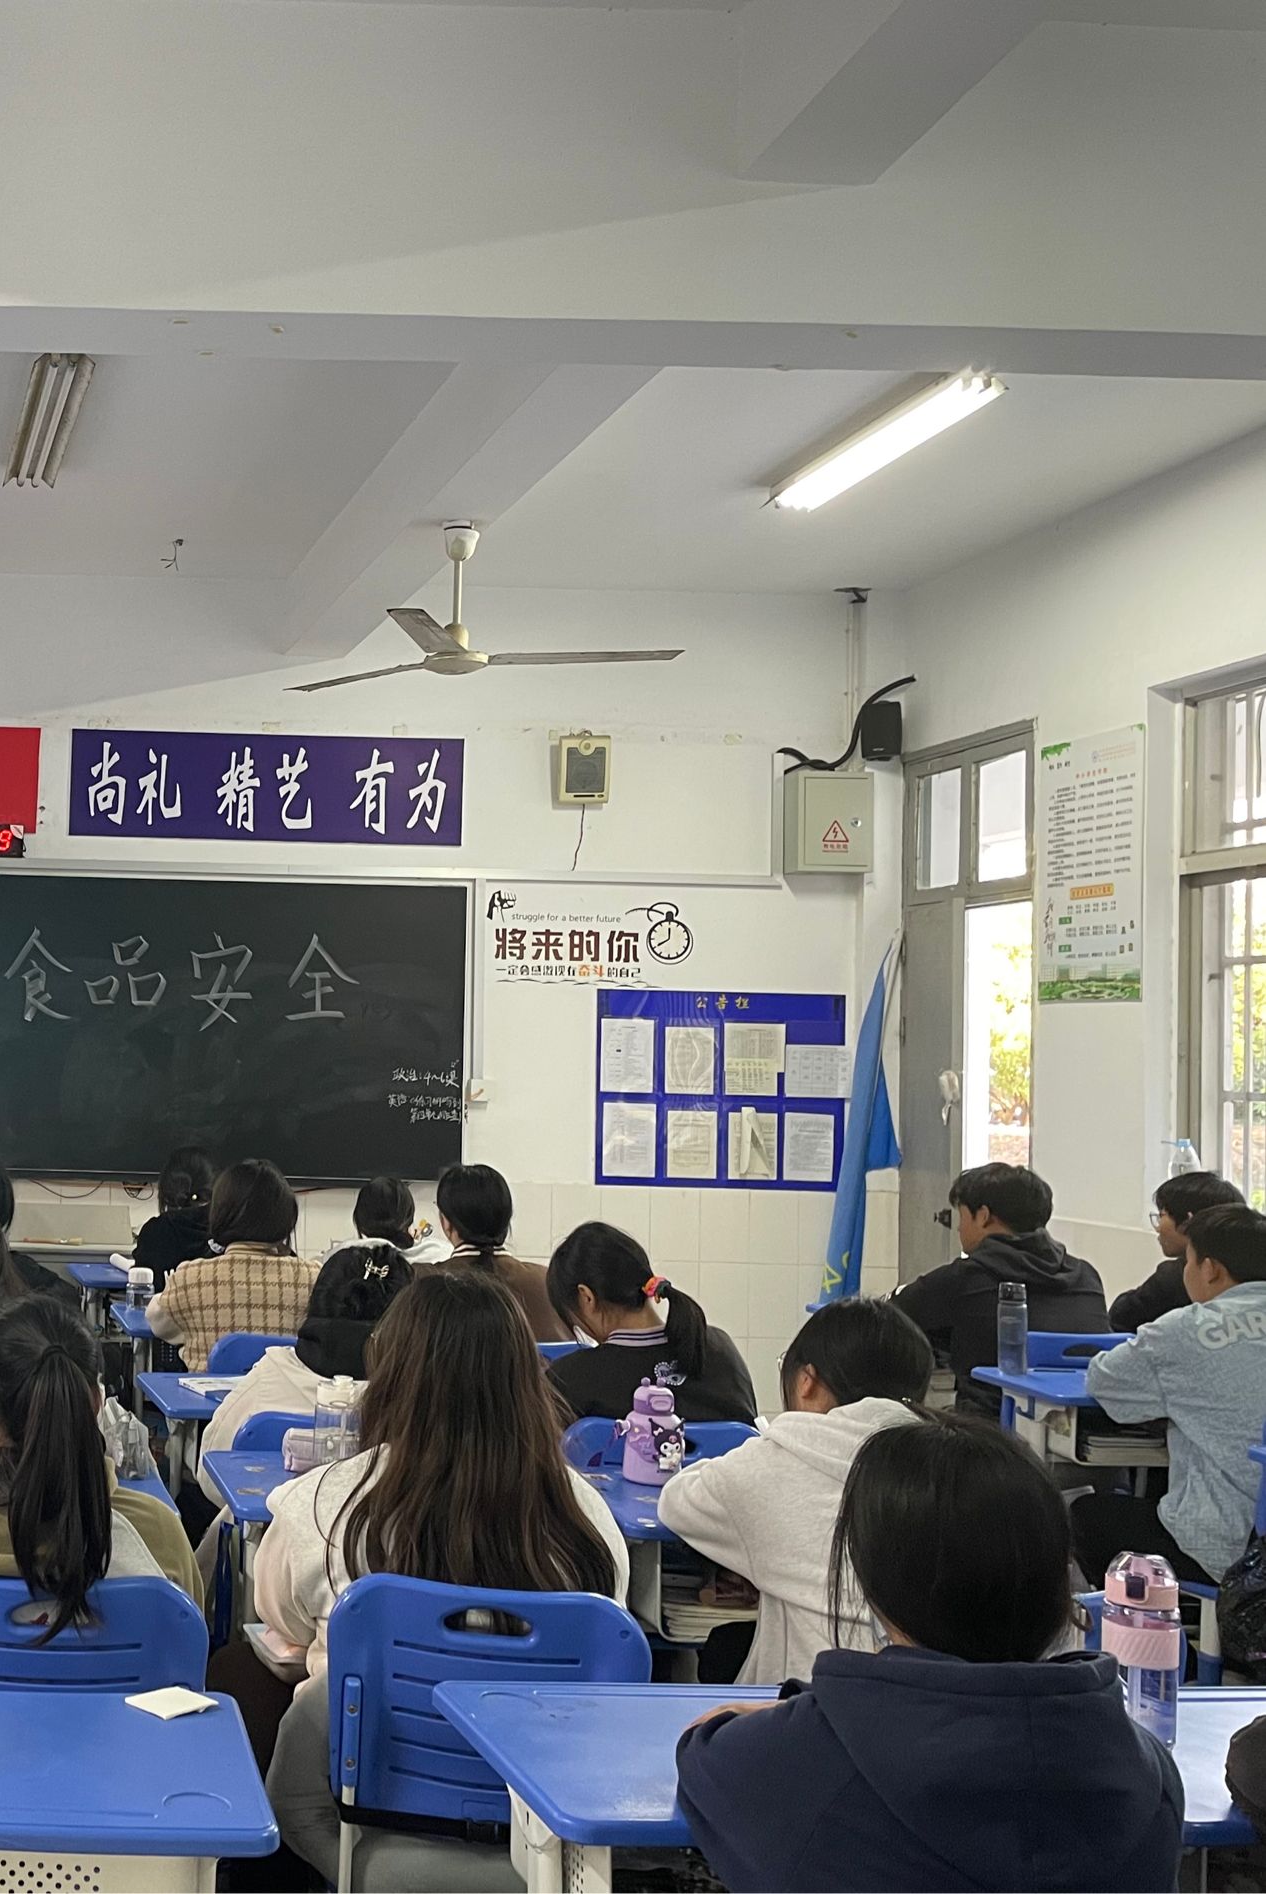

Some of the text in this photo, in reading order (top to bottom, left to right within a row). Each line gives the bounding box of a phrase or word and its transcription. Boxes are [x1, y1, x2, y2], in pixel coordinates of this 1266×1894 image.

[87, 741, 447, 835] 尚礼 精艺 有为
[512, 913, 545, 923] struggle
[547, 914, 559, 922] for
[569, 914, 594, 923] better
[596, 915, 621, 923] future
[4, 927, 361, 1032] 食品安全
